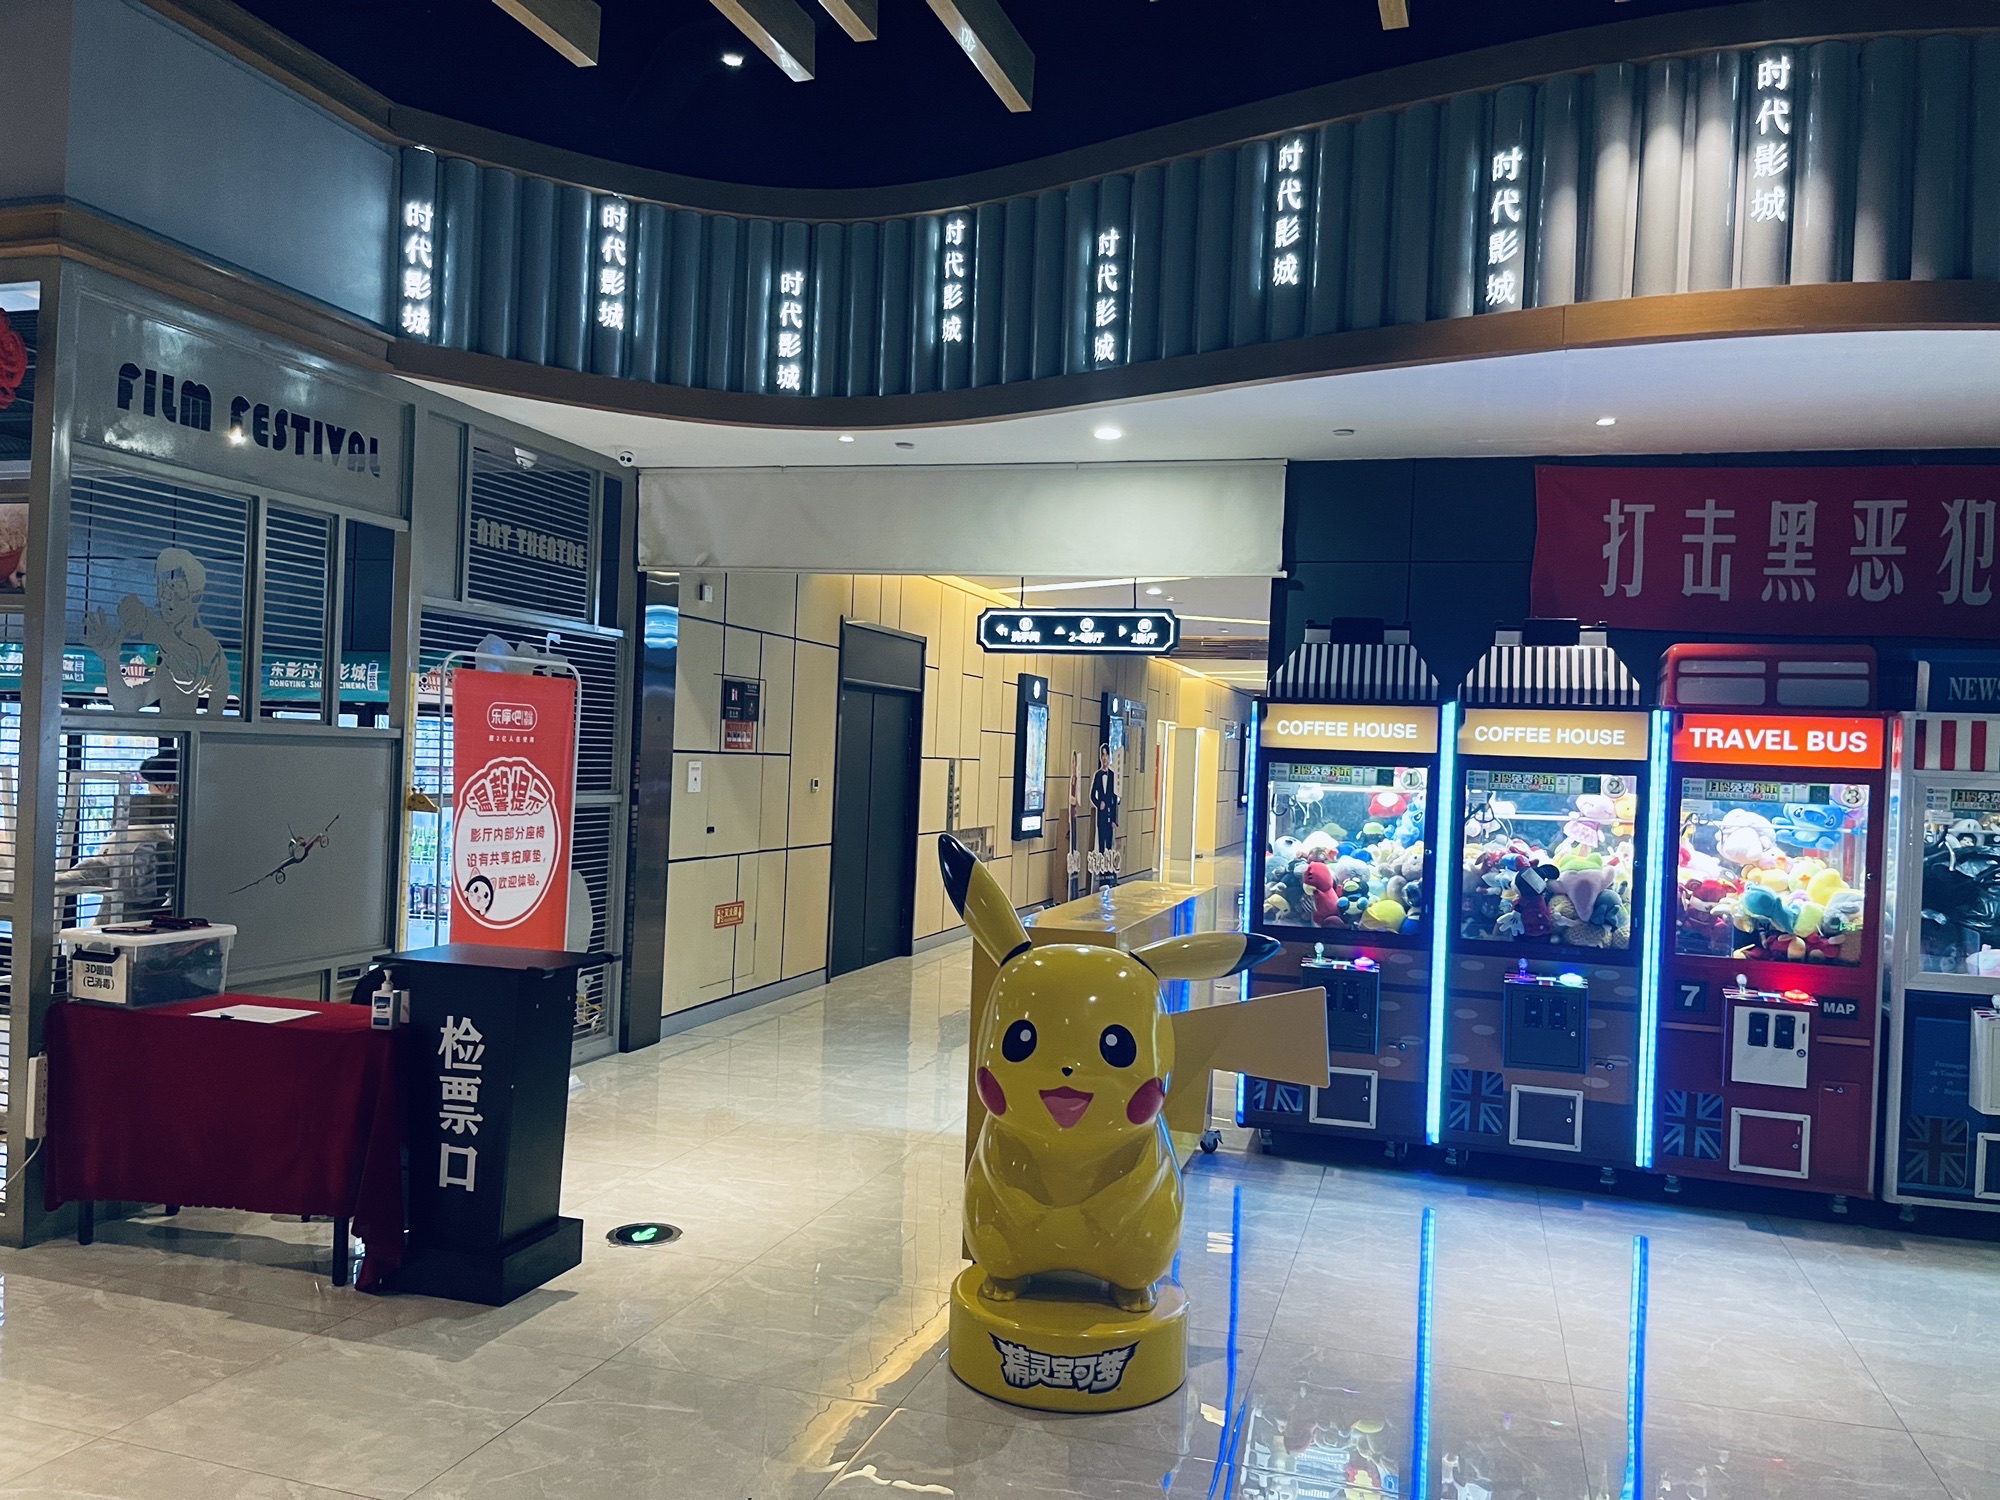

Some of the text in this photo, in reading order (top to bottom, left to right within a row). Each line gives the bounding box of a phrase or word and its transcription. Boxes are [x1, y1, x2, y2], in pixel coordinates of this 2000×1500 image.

[1751, 56, 1790, 223] 时代影城
[1273, 139, 1303, 287] 时代影城
[1486, 147, 1522, 306] 时代影城
[402, 202, 434, 336] 时代影城
[599, 204, 628, 330] 时代影城
[942, 219, 965, 343] 时代影城
[1094, 228, 1119, 362] 时代影城
[777, 271, 804, 390] 时代影城
[117, 362, 380, 478] FILM FESTIVAL
[477, 518, 585, 568] ART THEATRE
[1600, 498, 1997, 605] 打击黑恶犯
[269, 679, 306, 688] DONGYING
[1948, 677, 2000, 700] NEW
[491, 708, 522, 726] 乐摩吧
[1276, 719, 1418, 740] COFFEE HOUSE
[1474, 725, 1625, 745] COFFEE HOUSE
[1689, 727, 1868, 753] TRAVEL BUS
[469, 768, 547, 812] 温馨提示
[1609, 780, 1621, 794] 2
[1847, 790, 1859, 804] 3
[470, 826, 545, 842] 影厅内部分座椅
[1680, 985, 1700, 1007] 7
[1823, 1001, 1856, 1016] MAP
[438, 1016, 483, 1192] 检票口
[995, 1340, 1134, 1393] 精灵宝可梦
